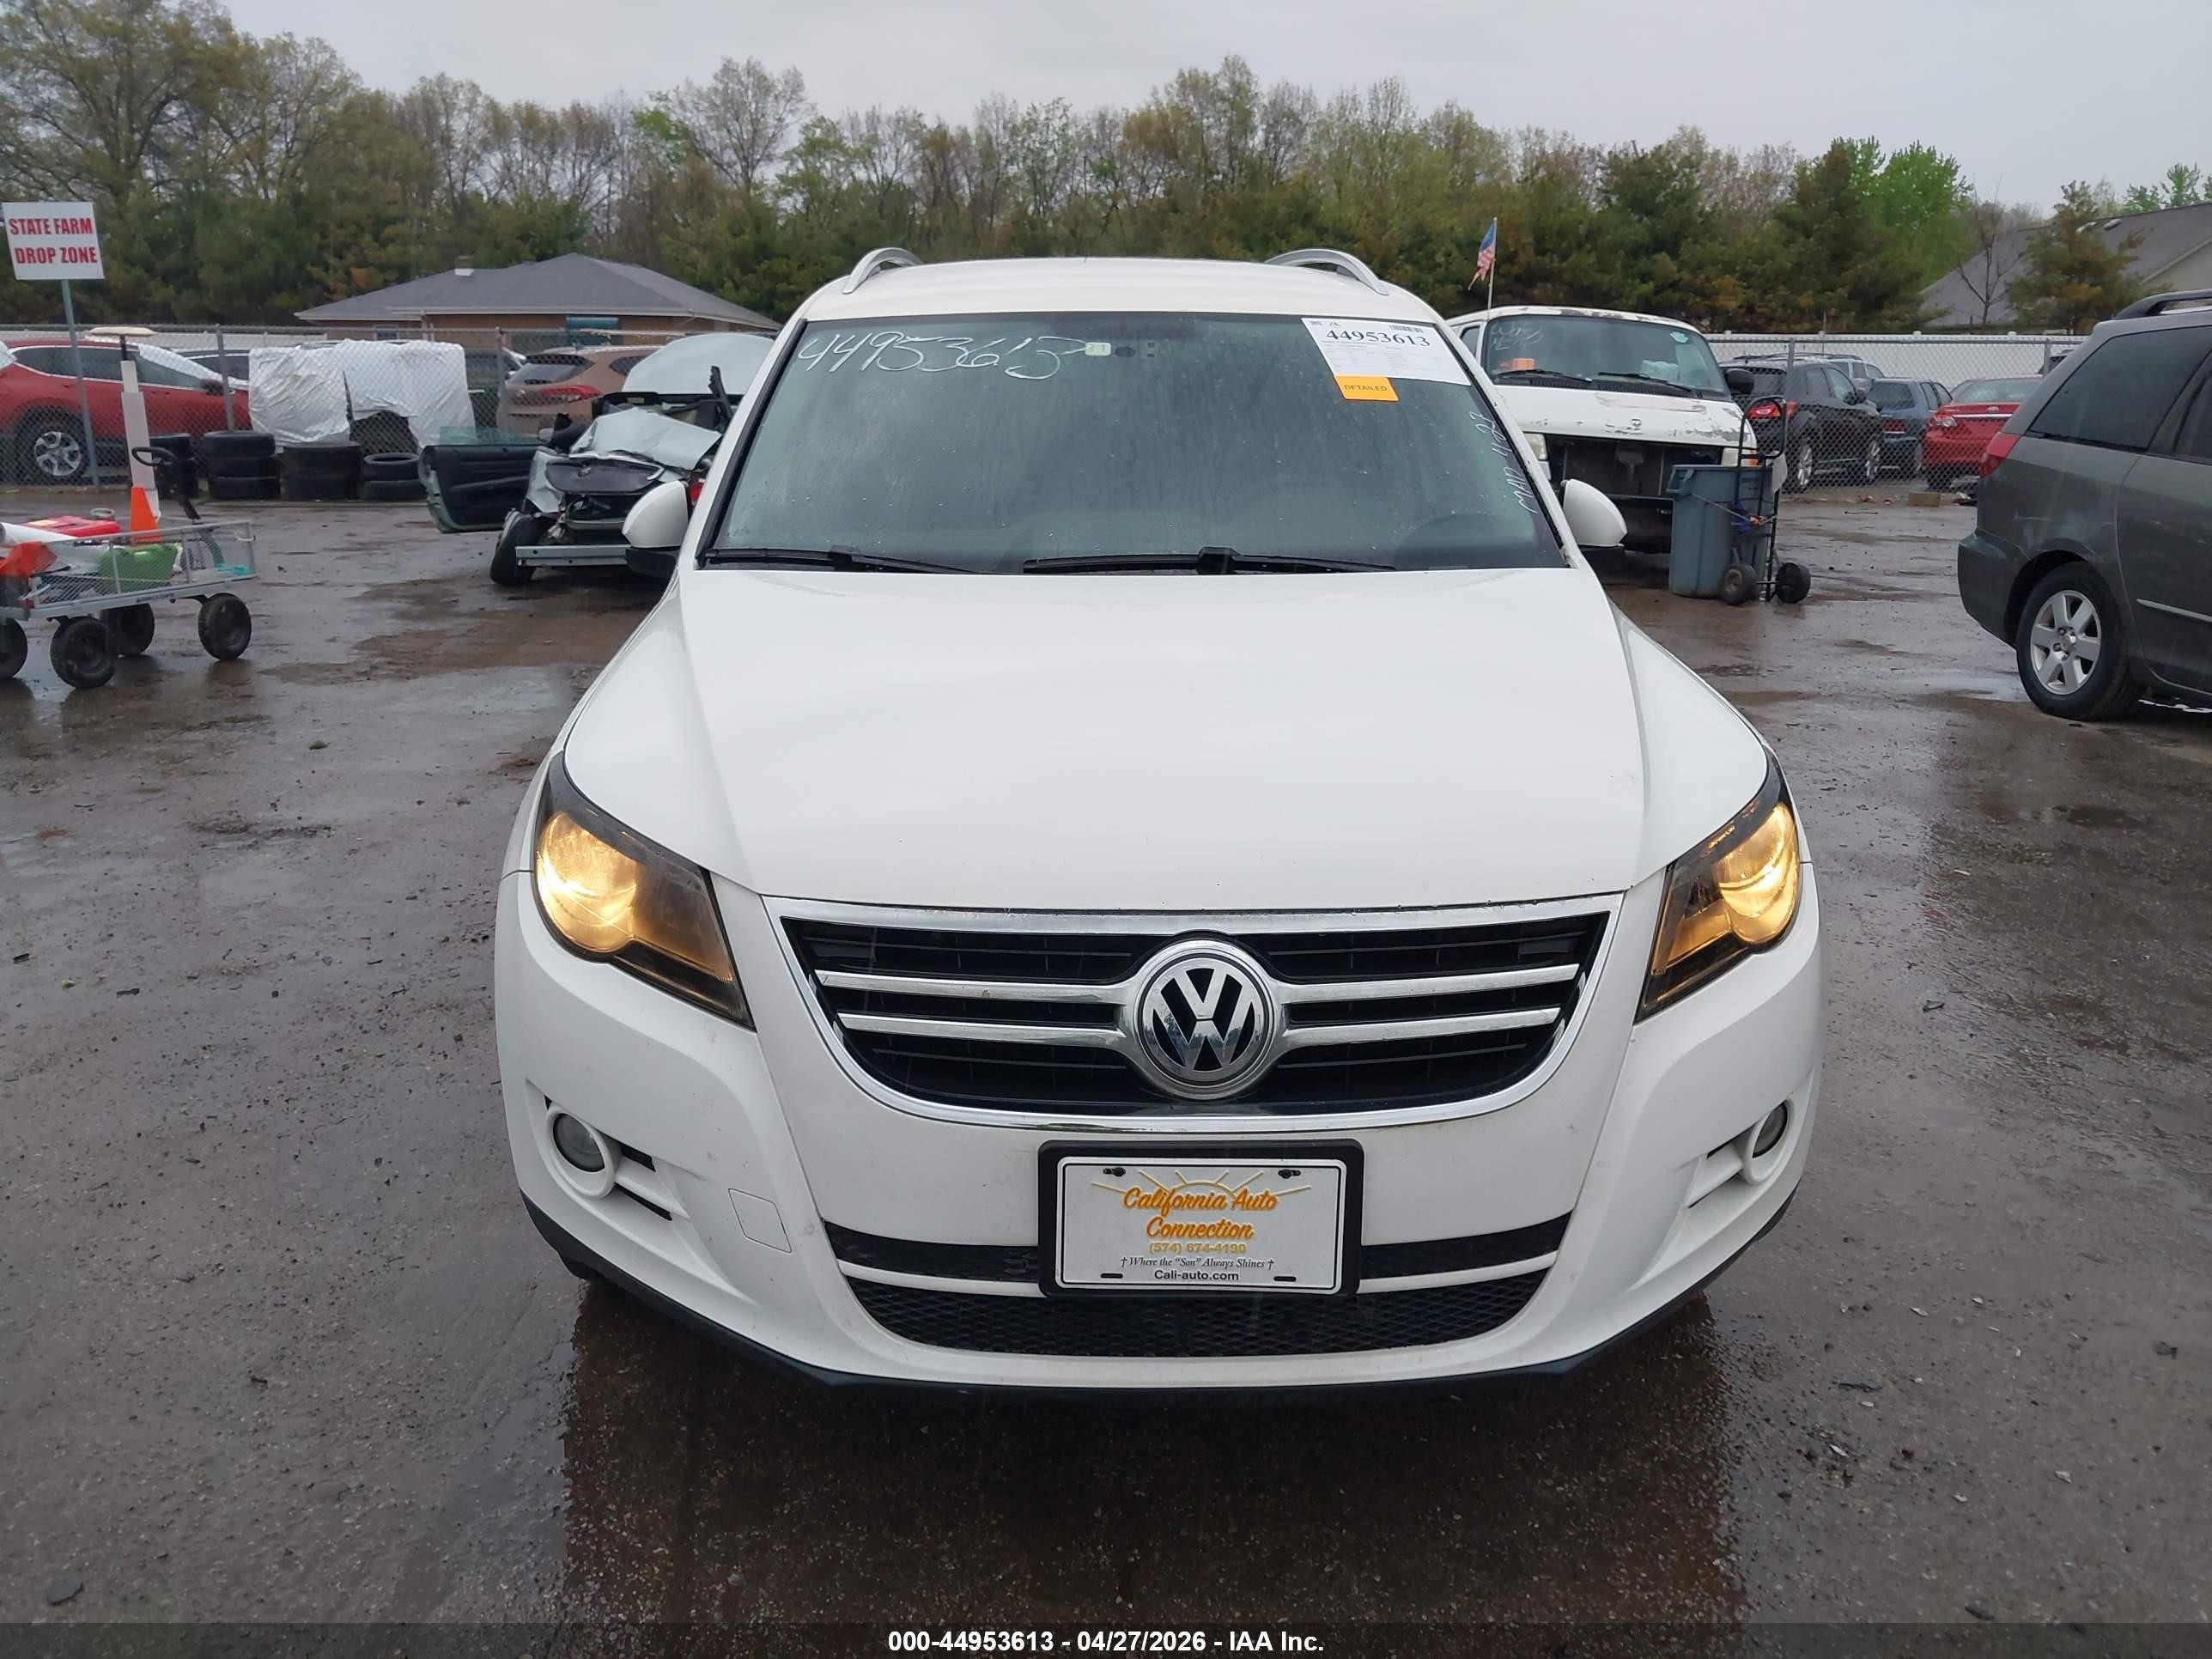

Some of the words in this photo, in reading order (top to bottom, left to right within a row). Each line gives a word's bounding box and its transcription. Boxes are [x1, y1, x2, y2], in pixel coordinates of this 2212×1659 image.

[9, 218, 51, 235] STATE
[54, 218, 93, 234] FARM
[15, 247, 55, 264] DROP
[59, 246, 97, 263] ZONE
[1327, 330, 1430, 347] 44953613
[1123, 1187, 1227, 1217] California
[1231, 1187, 1279, 1210] Auto
[1146, 1216, 1255, 1238] Connection
[1150, 1242, 1182, 1254] (574)
[1129, 1257, 1158, 1267] Where
[1159, 1257, 1172, 1267] the
[1202, 1258, 1234, 1269] Always
[1236, 1259, 1265, 1267] Shines
[1154, 1270, 1239, 1281] Cali-auto.com
